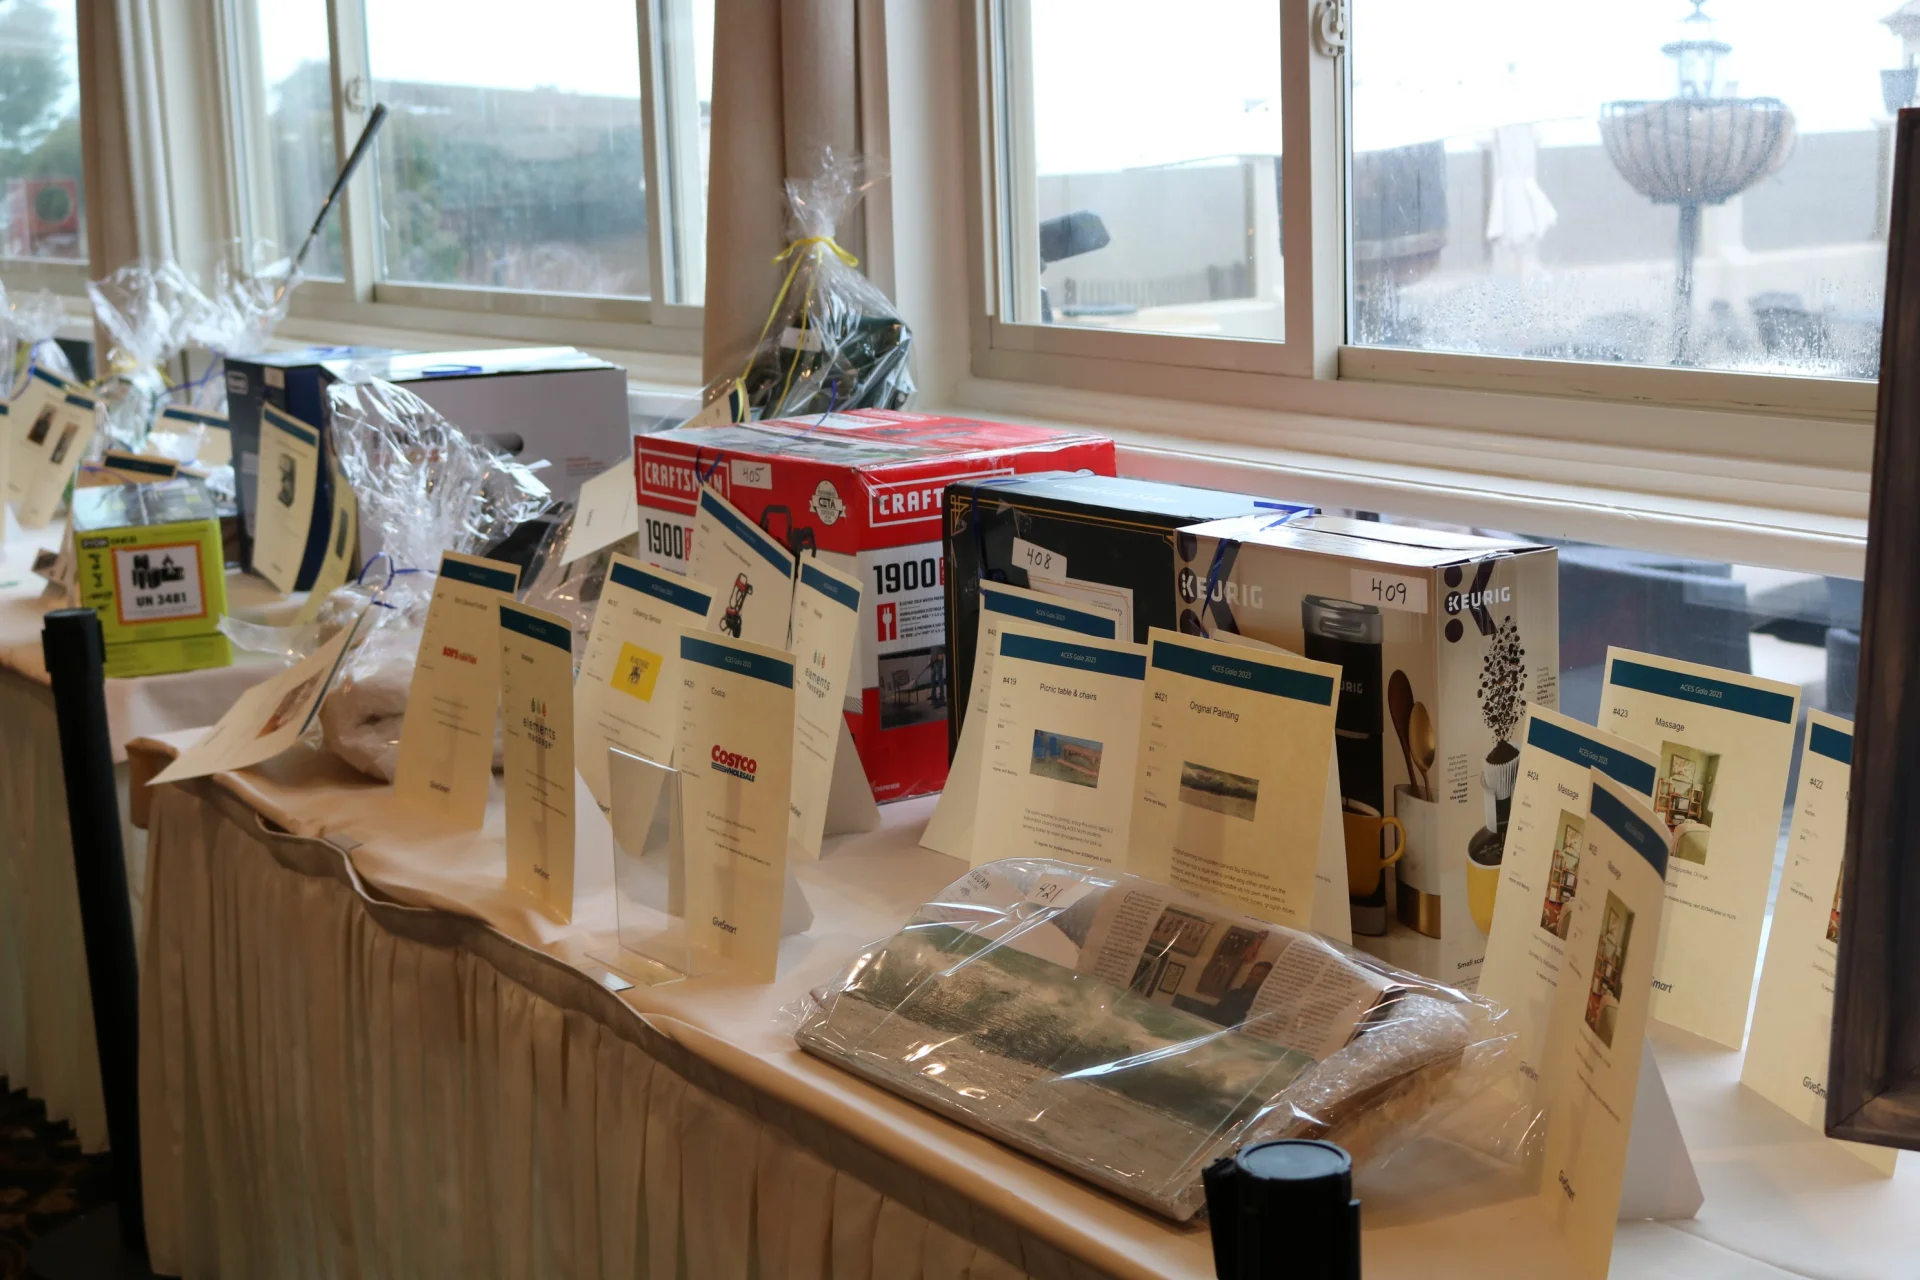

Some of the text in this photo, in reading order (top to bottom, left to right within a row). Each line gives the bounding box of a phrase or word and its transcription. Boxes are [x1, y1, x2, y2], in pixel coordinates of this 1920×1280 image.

[742, 467, 764, 483] 405
[645, 518, 684, 560] 1900
[1027, 547, 1052, 570] 408
[873, 558, 936, 595] 1900
[157, 592, 187, 605] 3481
[1181, 573, 1264, 609] KEURIG
[1371, 578, 1407, 604] 409
[1448, 586, 1511, 612] KEURIG
[1060, 651, 1073, 660] ACES
[1085, 655, 1097, 664] 2023
[805, 667, 831, 691] elements
[1211, 664, 1252, 679] ACES Gala 2023
[1002, 676, 1017, 686] #419
[711, 687, 726, 699] Costco
[1039, 682, 1057, 694] Picnic
[1057, 686, 1072, 696] table
[1079, 691, 1097, 700] chairs
[1154, 691, 1168, 702] #421
[1680, 683, 1723, 699] ACES Gala 2023
[1189, 700, 1240, 723] Original Painting
[1612, 707, 1629, 718] #423
[523, 717, 556, 740] elements
[1655, 717, 1685, 732] Massage
[711, 744, 757, 774] COSTCO
[724, 766, 755, 782] WHOLESALE
[1527, 769, 1539, 781] #424
[1557, 783, 1579, 801] Massage
[1809, 777, 1824, 790] #422
[970, 870, 991, 890] SCULPIN
[1035, 882, 1064, 902] 421
[712, 916, 737, 936] GiveSmart
[1457, 959, 1473, 970] Small
